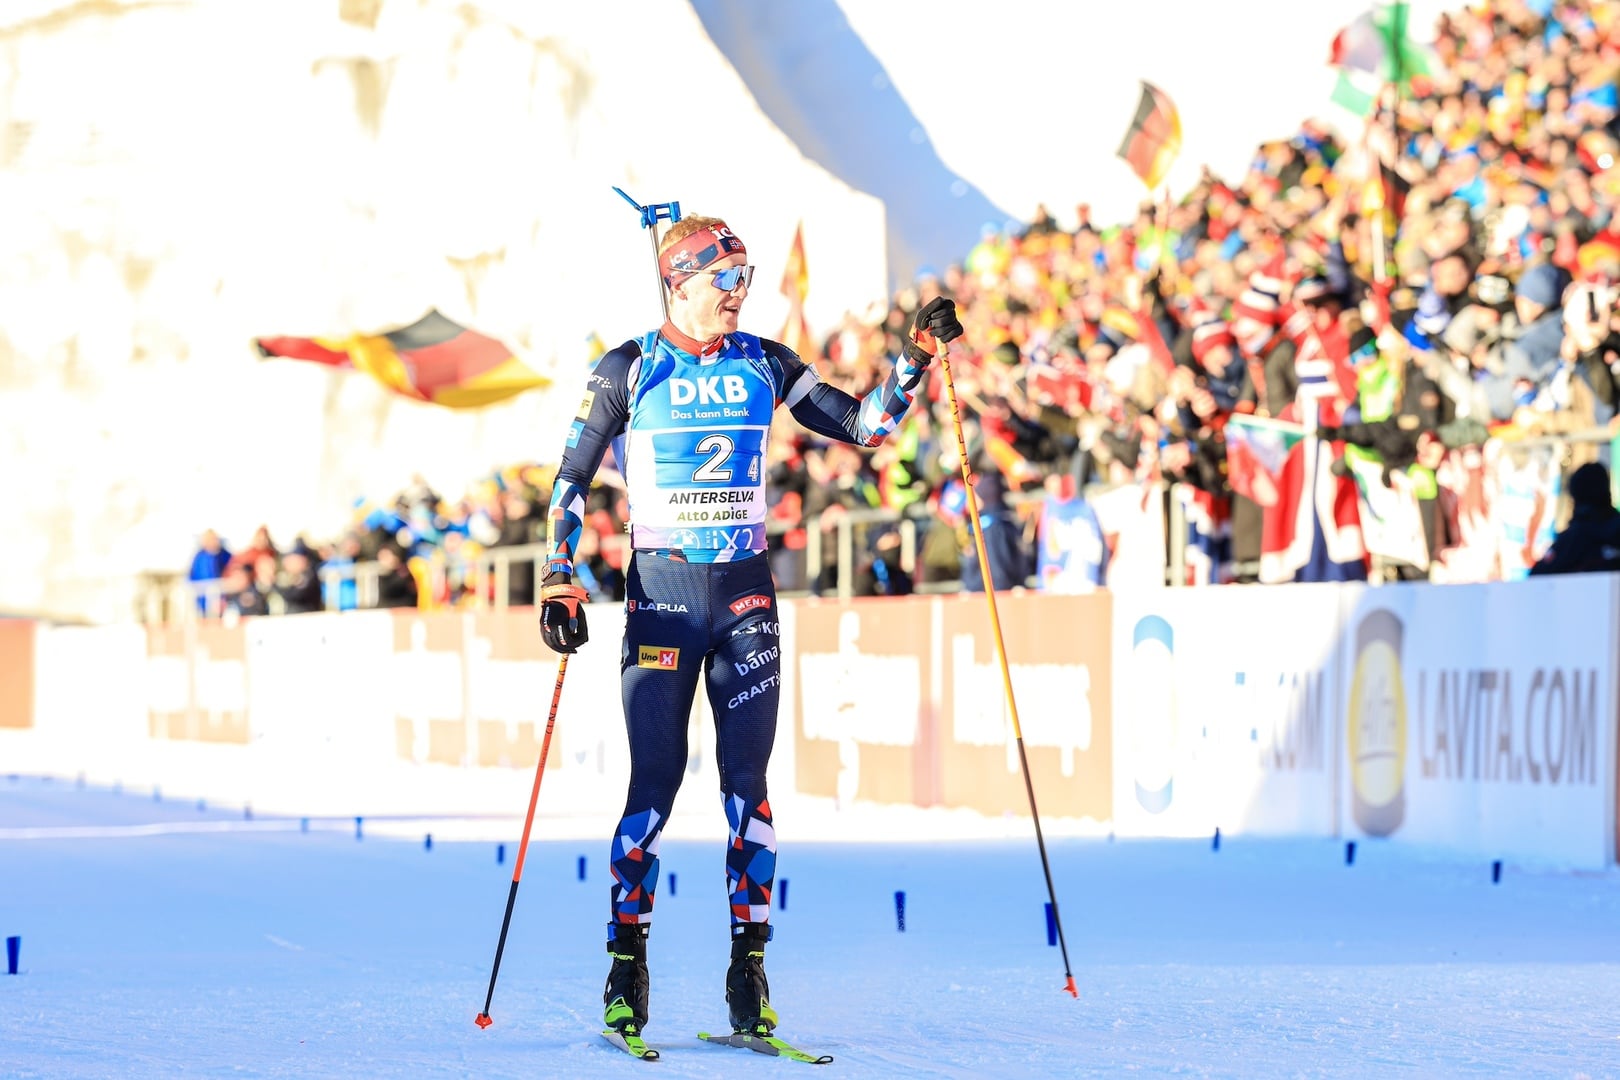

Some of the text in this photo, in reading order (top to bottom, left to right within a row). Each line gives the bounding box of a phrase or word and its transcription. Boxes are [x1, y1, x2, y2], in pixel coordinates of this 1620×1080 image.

[669, 375, 749, 406] DKB
[671, 407, 749, 420] Das kann Bank
[691, 433, 735, 483] 2
[747, 455, 759, 482] 4
[668, 490, 754, 505] ANTERSELVA
[638, 602, 688, 613] LAPUA
[735, 598, 767, 611] MENY
[641, 652, 674, 666] Uno X
[728, 675, 776, 709] CRAFT
[1418, 667, 1597, 786] LAVITA.COM
